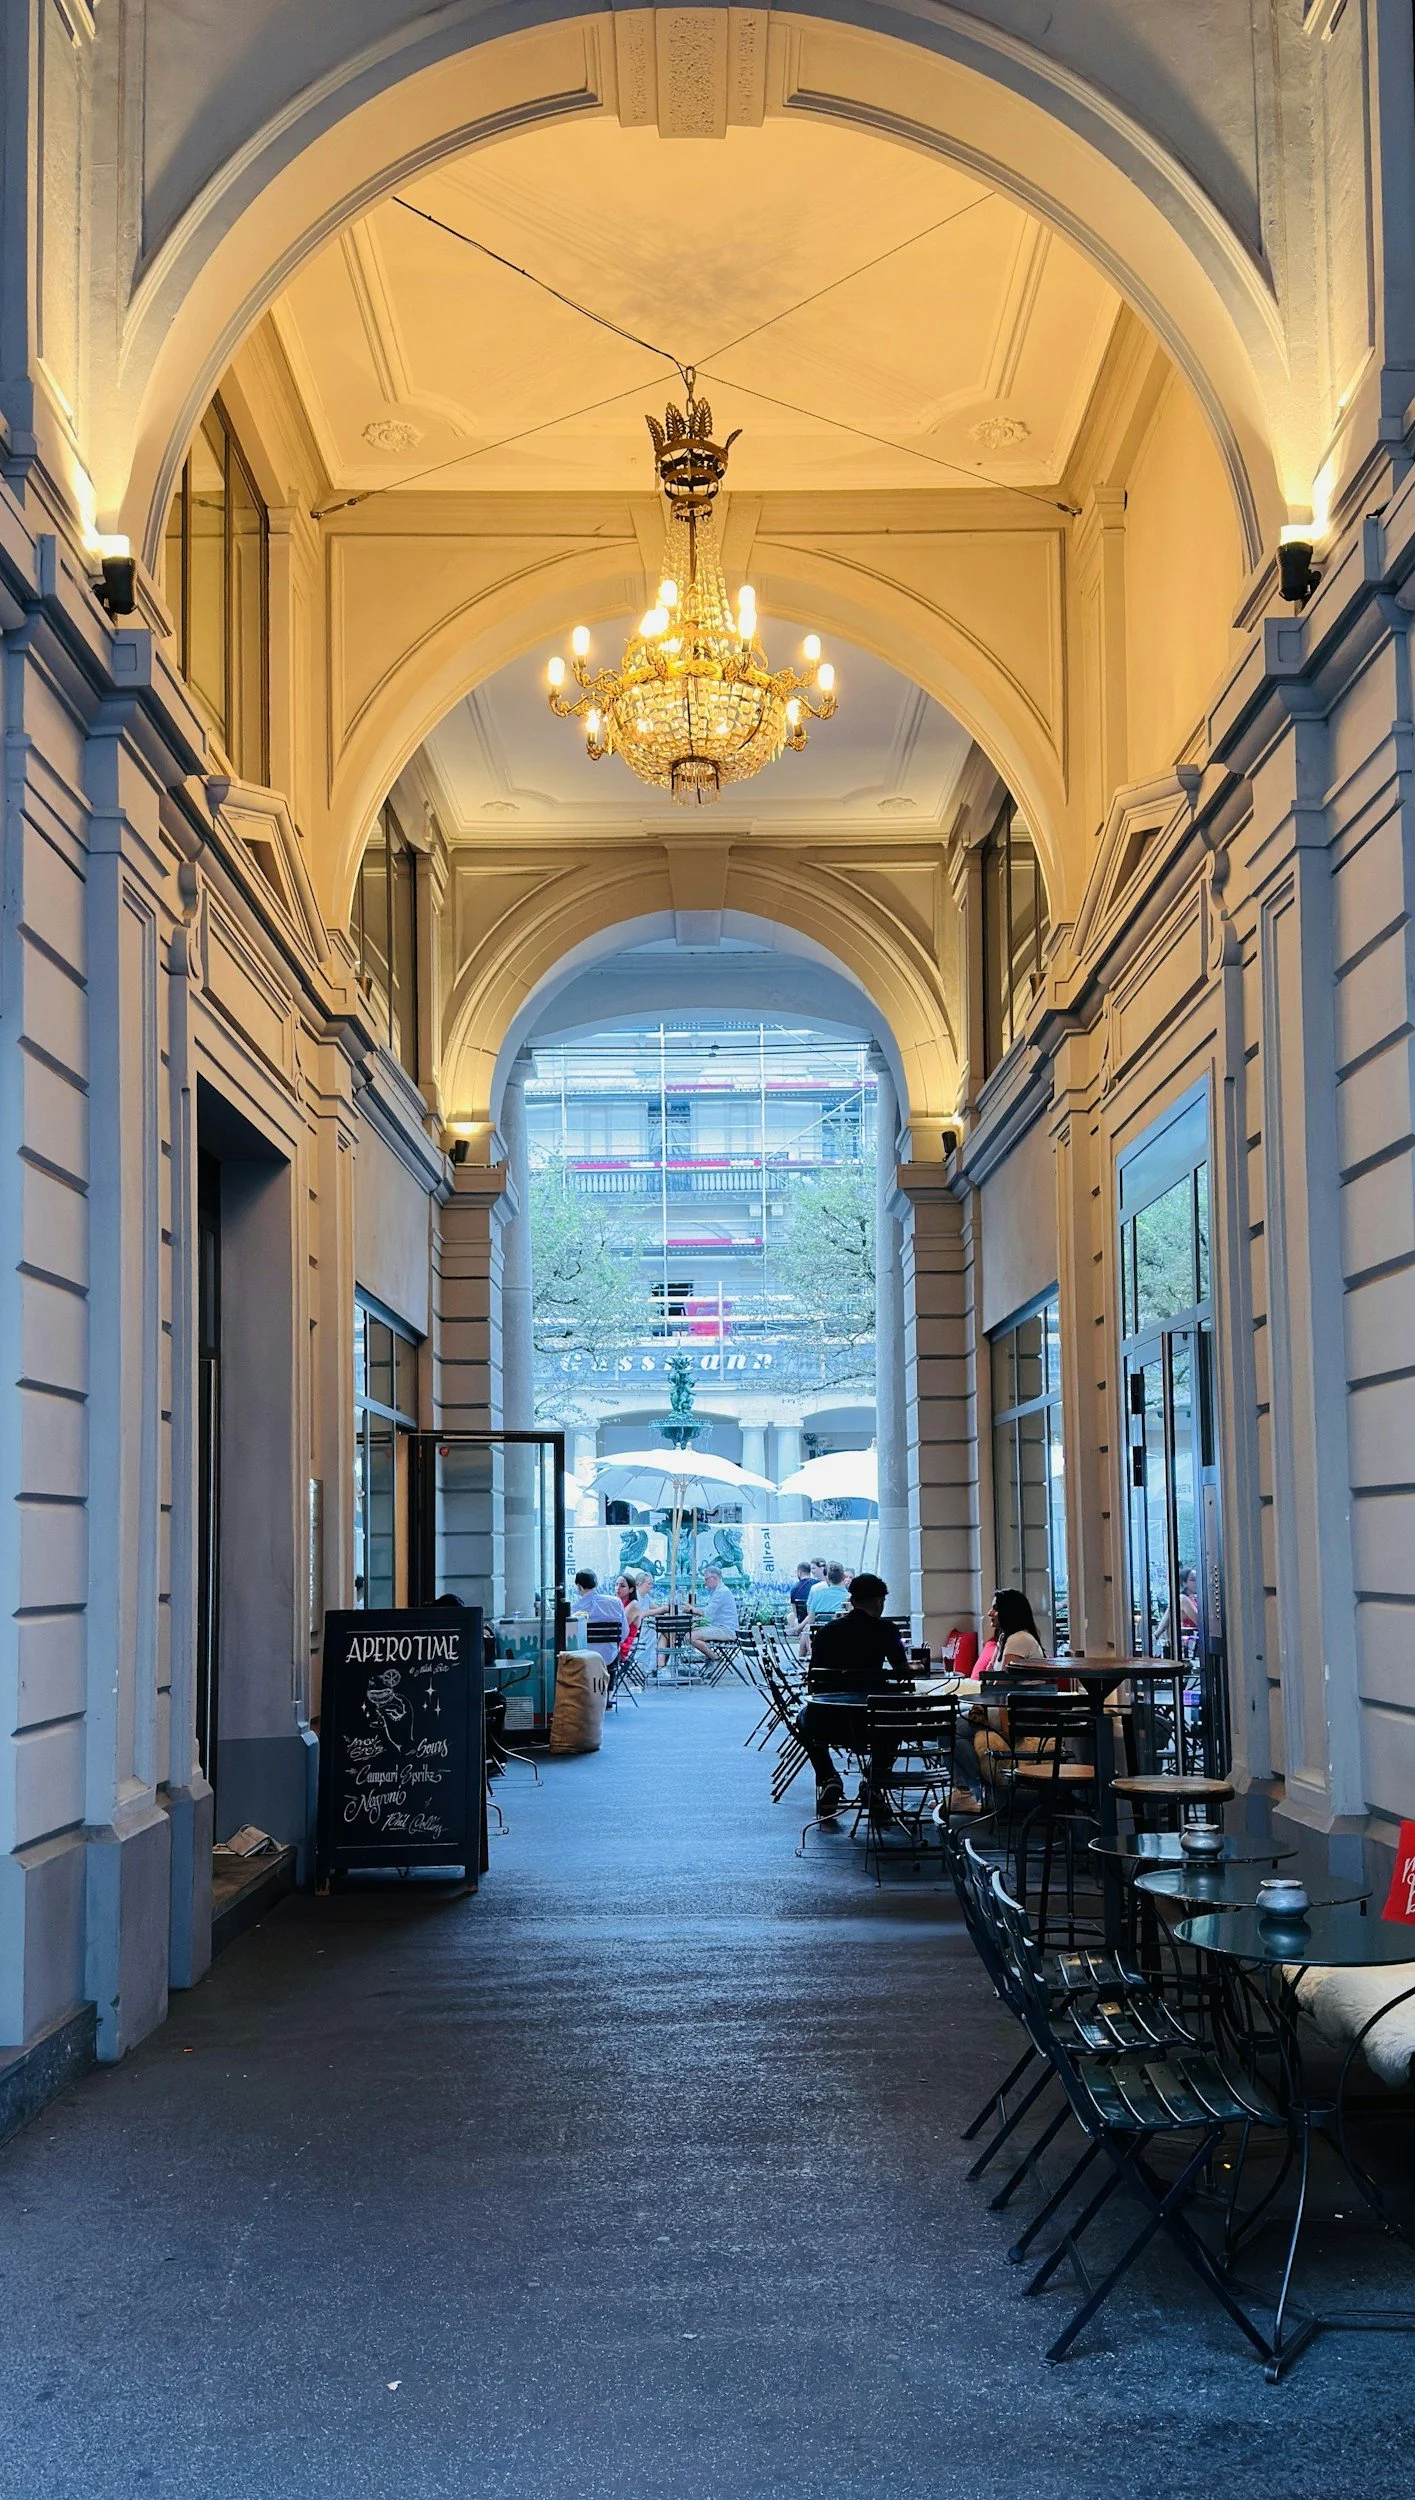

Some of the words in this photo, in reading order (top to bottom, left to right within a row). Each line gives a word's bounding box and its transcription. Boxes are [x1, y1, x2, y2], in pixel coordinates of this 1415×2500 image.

[564, 1532, 576, 1576] allreal
[761, 1528, 775, 1572] allreal
[345, 1635, 460, 1663] APEROTIME
[355, 1764, 398, 1787] Campari
[400, 1764, 442, 1787] Spritz
